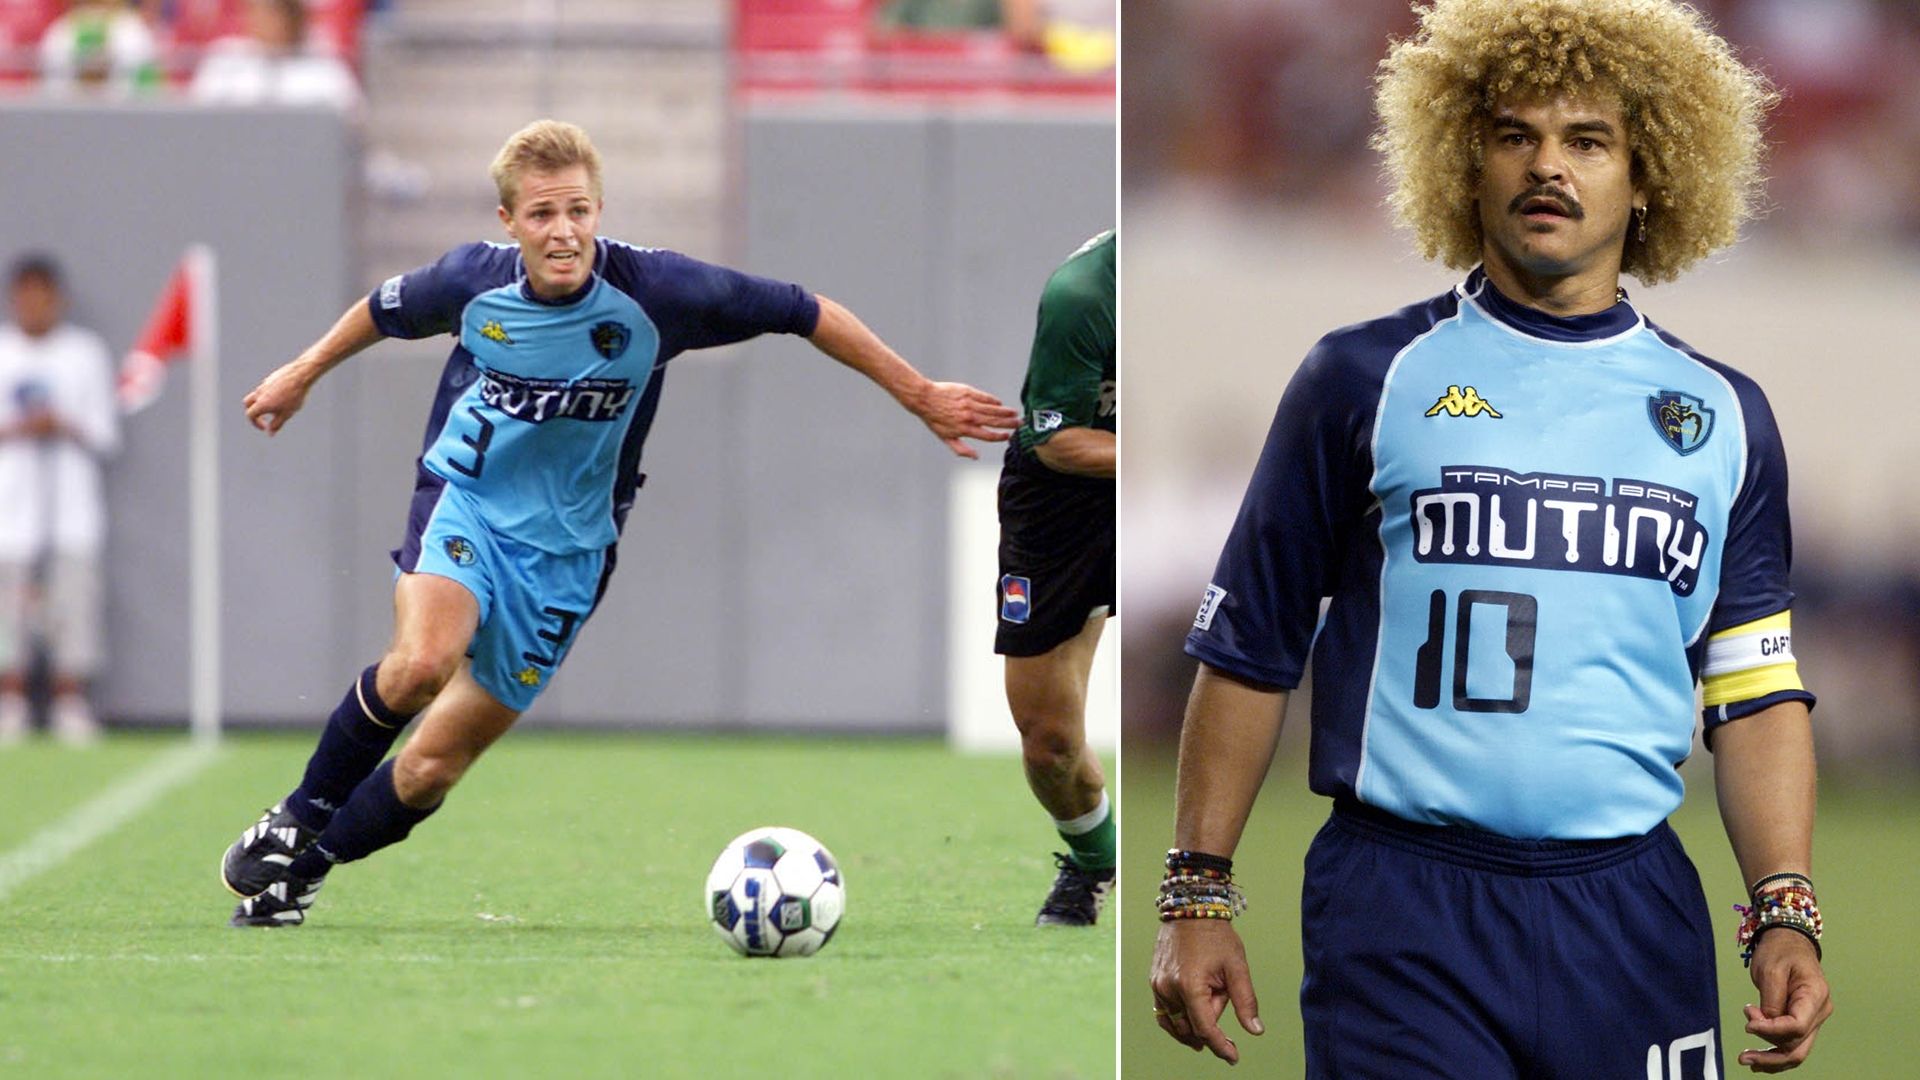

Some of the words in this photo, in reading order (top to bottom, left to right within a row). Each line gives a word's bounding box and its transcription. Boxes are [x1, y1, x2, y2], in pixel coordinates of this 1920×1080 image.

[447, 406, 494, 479] 3
[1445, 471, 1599, 494] TAMPA
[1618, 484, 1694, 508] BAY
[1416, 492, 1703, 582] MUTINY
[1676, 578, 1689, 591] TM
[522, 606, 578, 667] 3
[1413, 588, 1538, 714] 10
